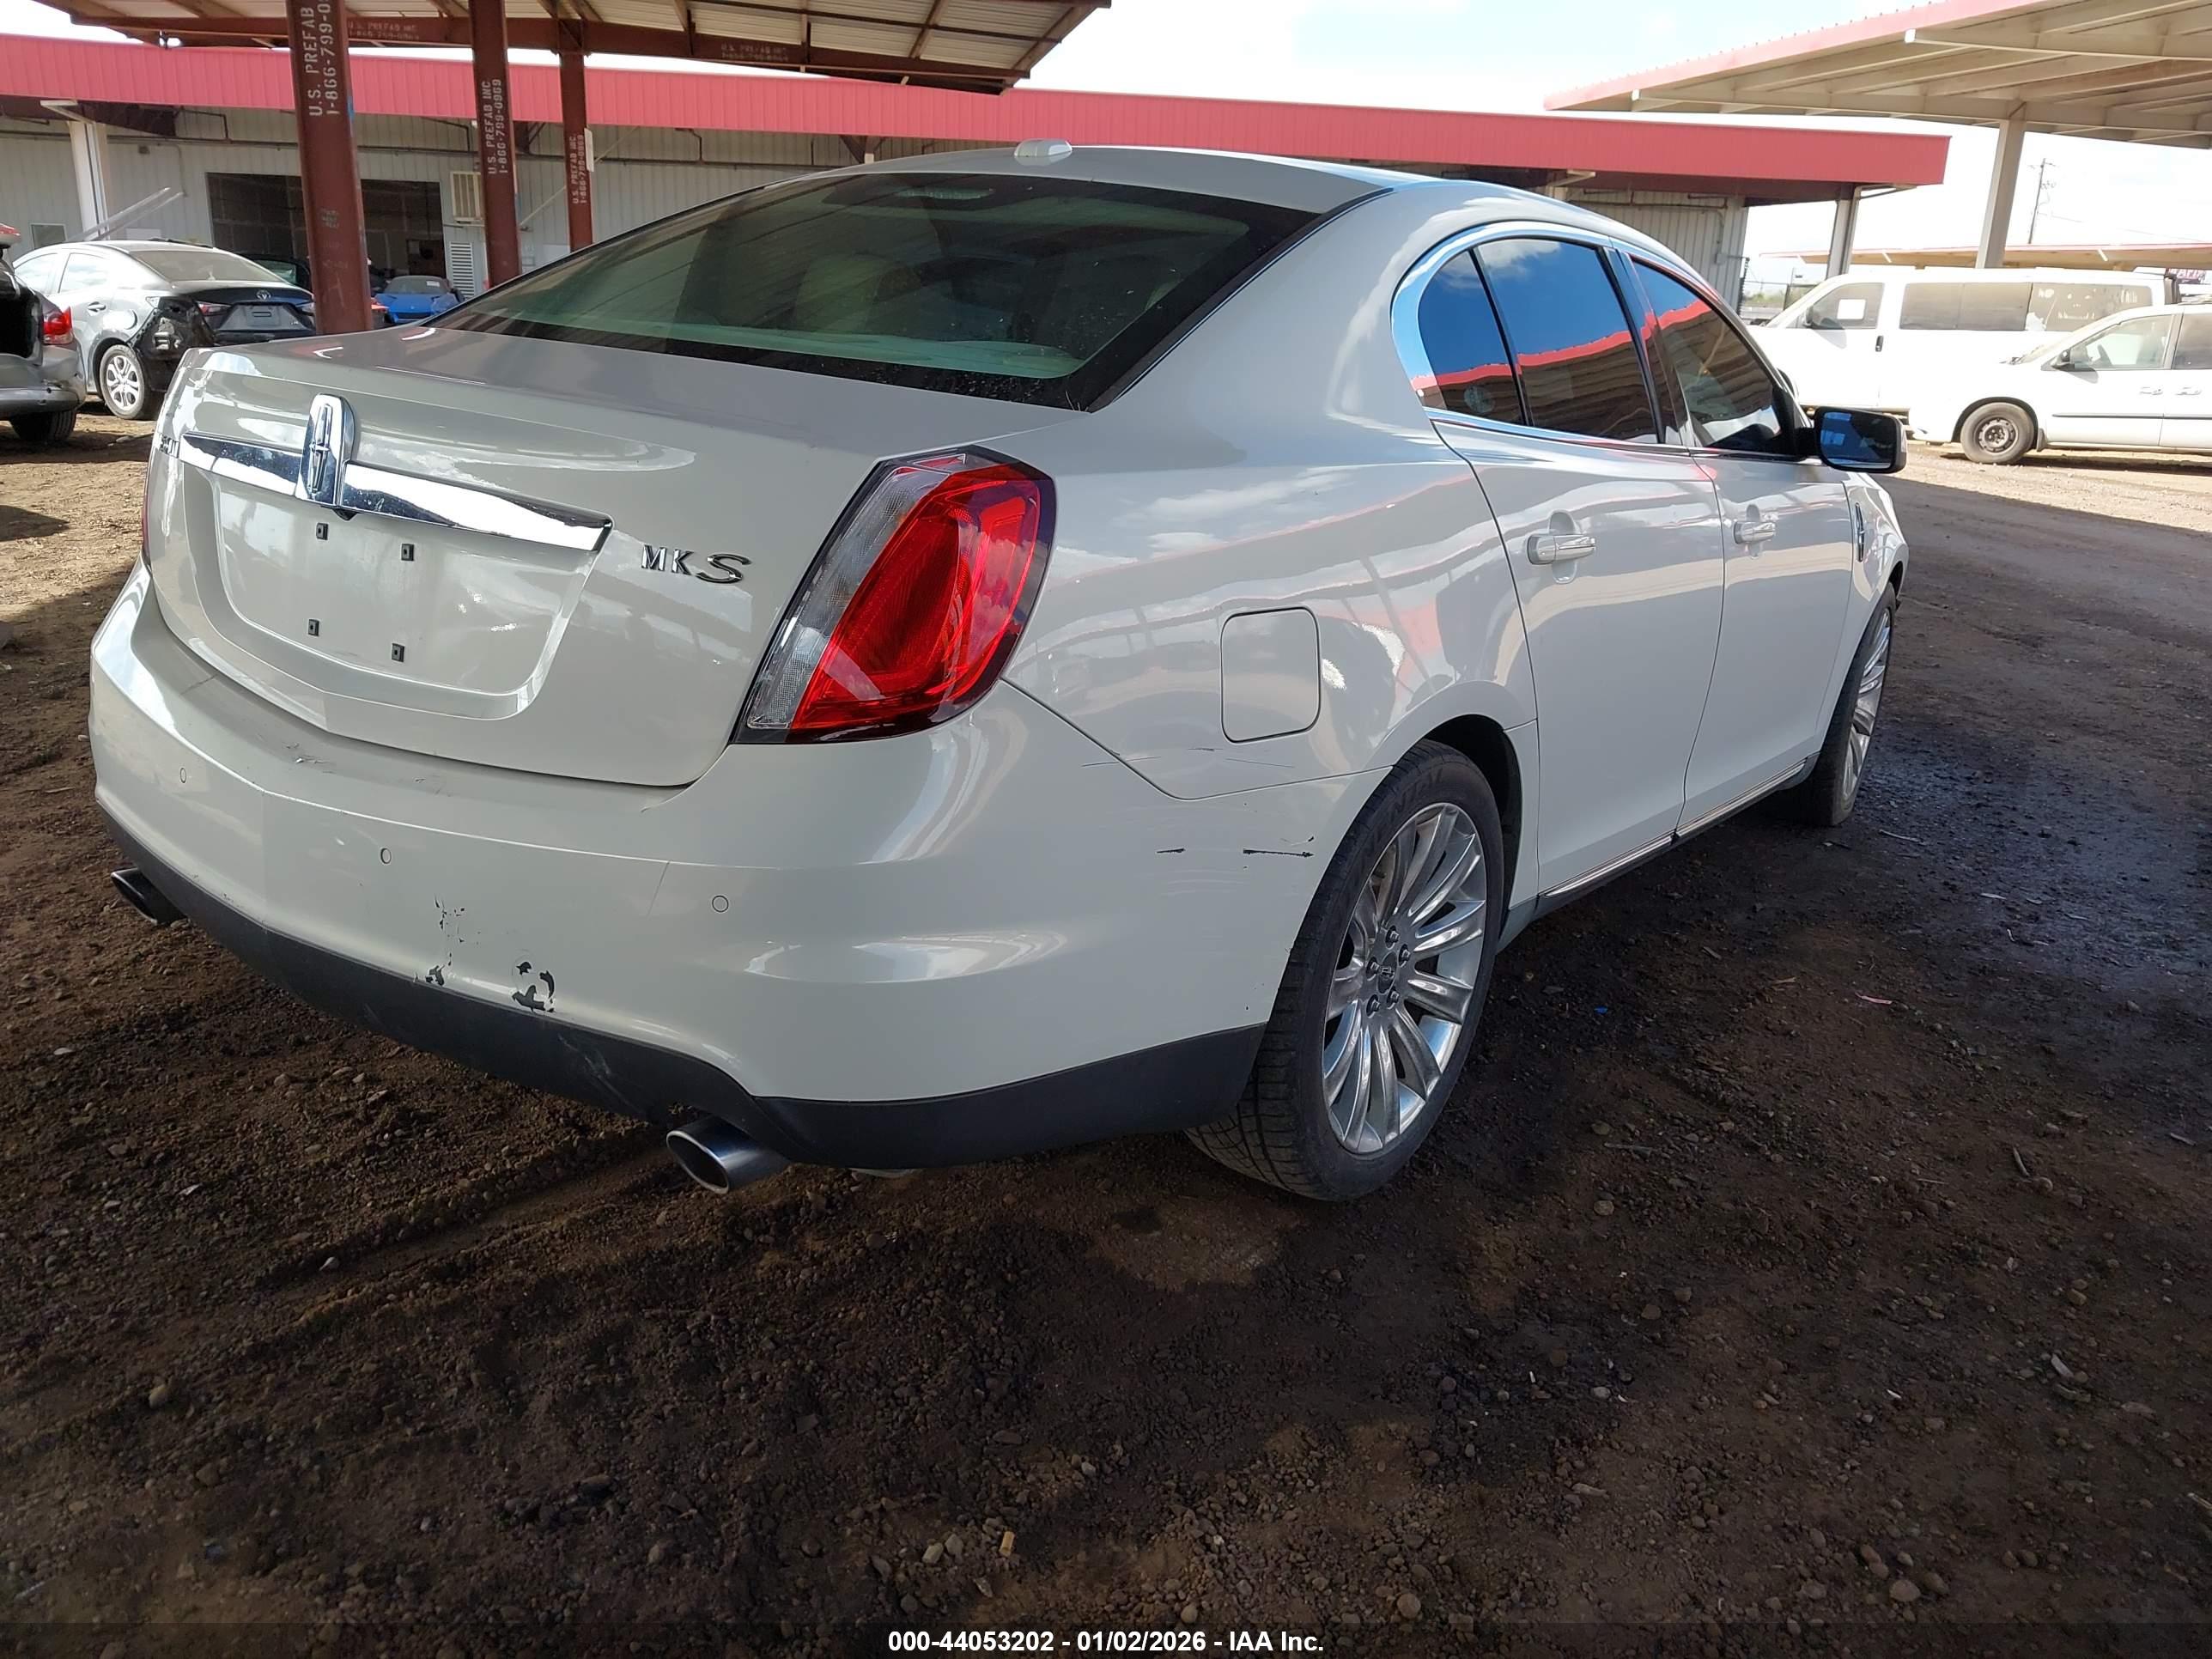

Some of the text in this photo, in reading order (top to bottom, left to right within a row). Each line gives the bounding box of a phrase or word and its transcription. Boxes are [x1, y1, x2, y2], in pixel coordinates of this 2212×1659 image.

[300, 7, 323, 116] U.S. PREFAB
[316, 0, 340, 115] 1-866-799-0
[483, 104, 495, 148] PREFAB
[492, 79, 508, 173] 1-866-799-0969
[488, 153, 497, 174] U.S.
[641, 544, 752, 584] MKS
